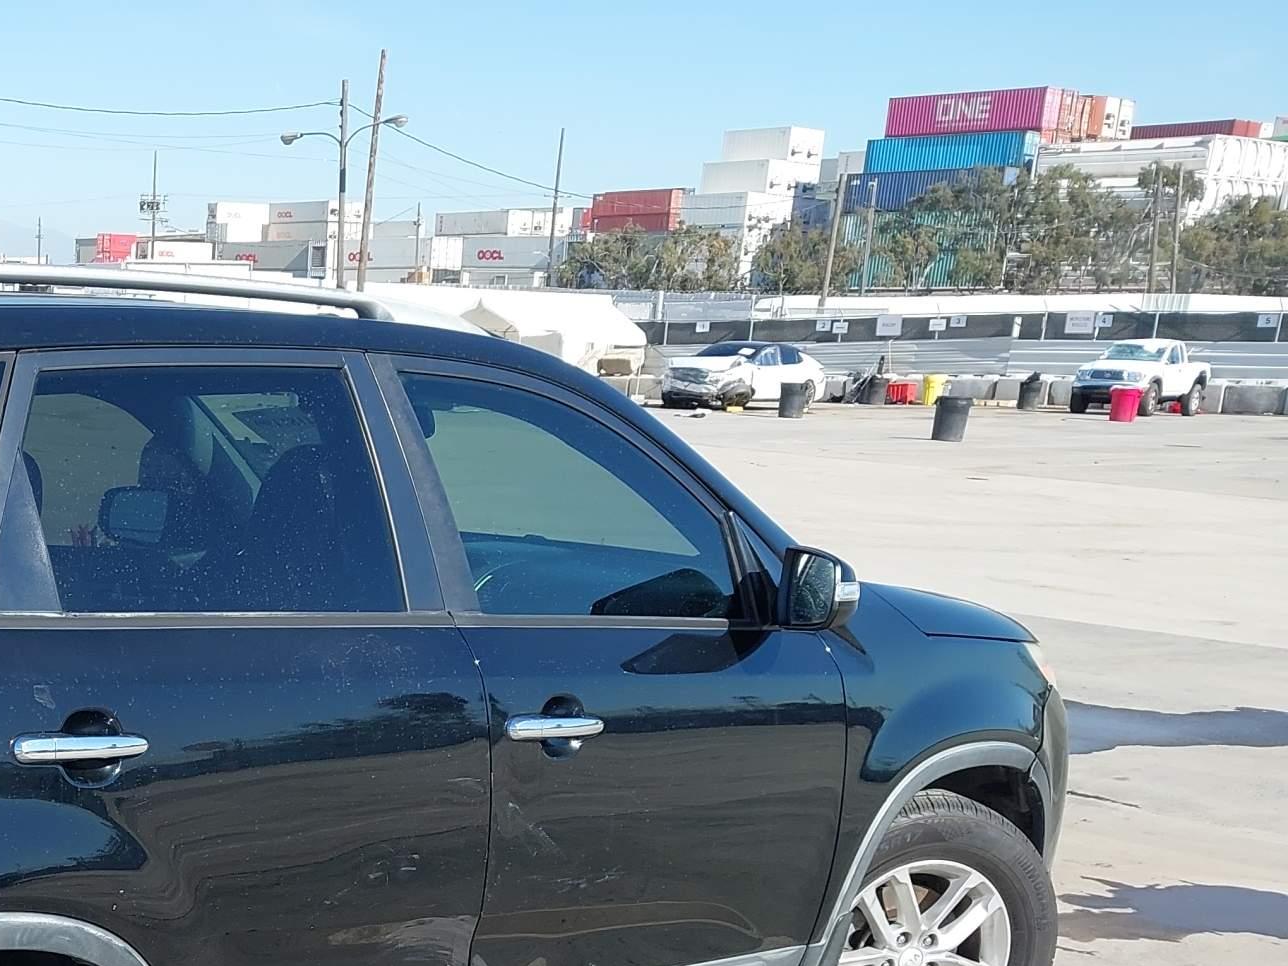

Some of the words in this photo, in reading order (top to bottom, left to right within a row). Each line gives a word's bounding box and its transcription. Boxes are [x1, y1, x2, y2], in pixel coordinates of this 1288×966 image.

[935, 96, 992, 121] ONE
[348, 252, 373, 262] OOL
[477, 249, 504, 261] OOCL
